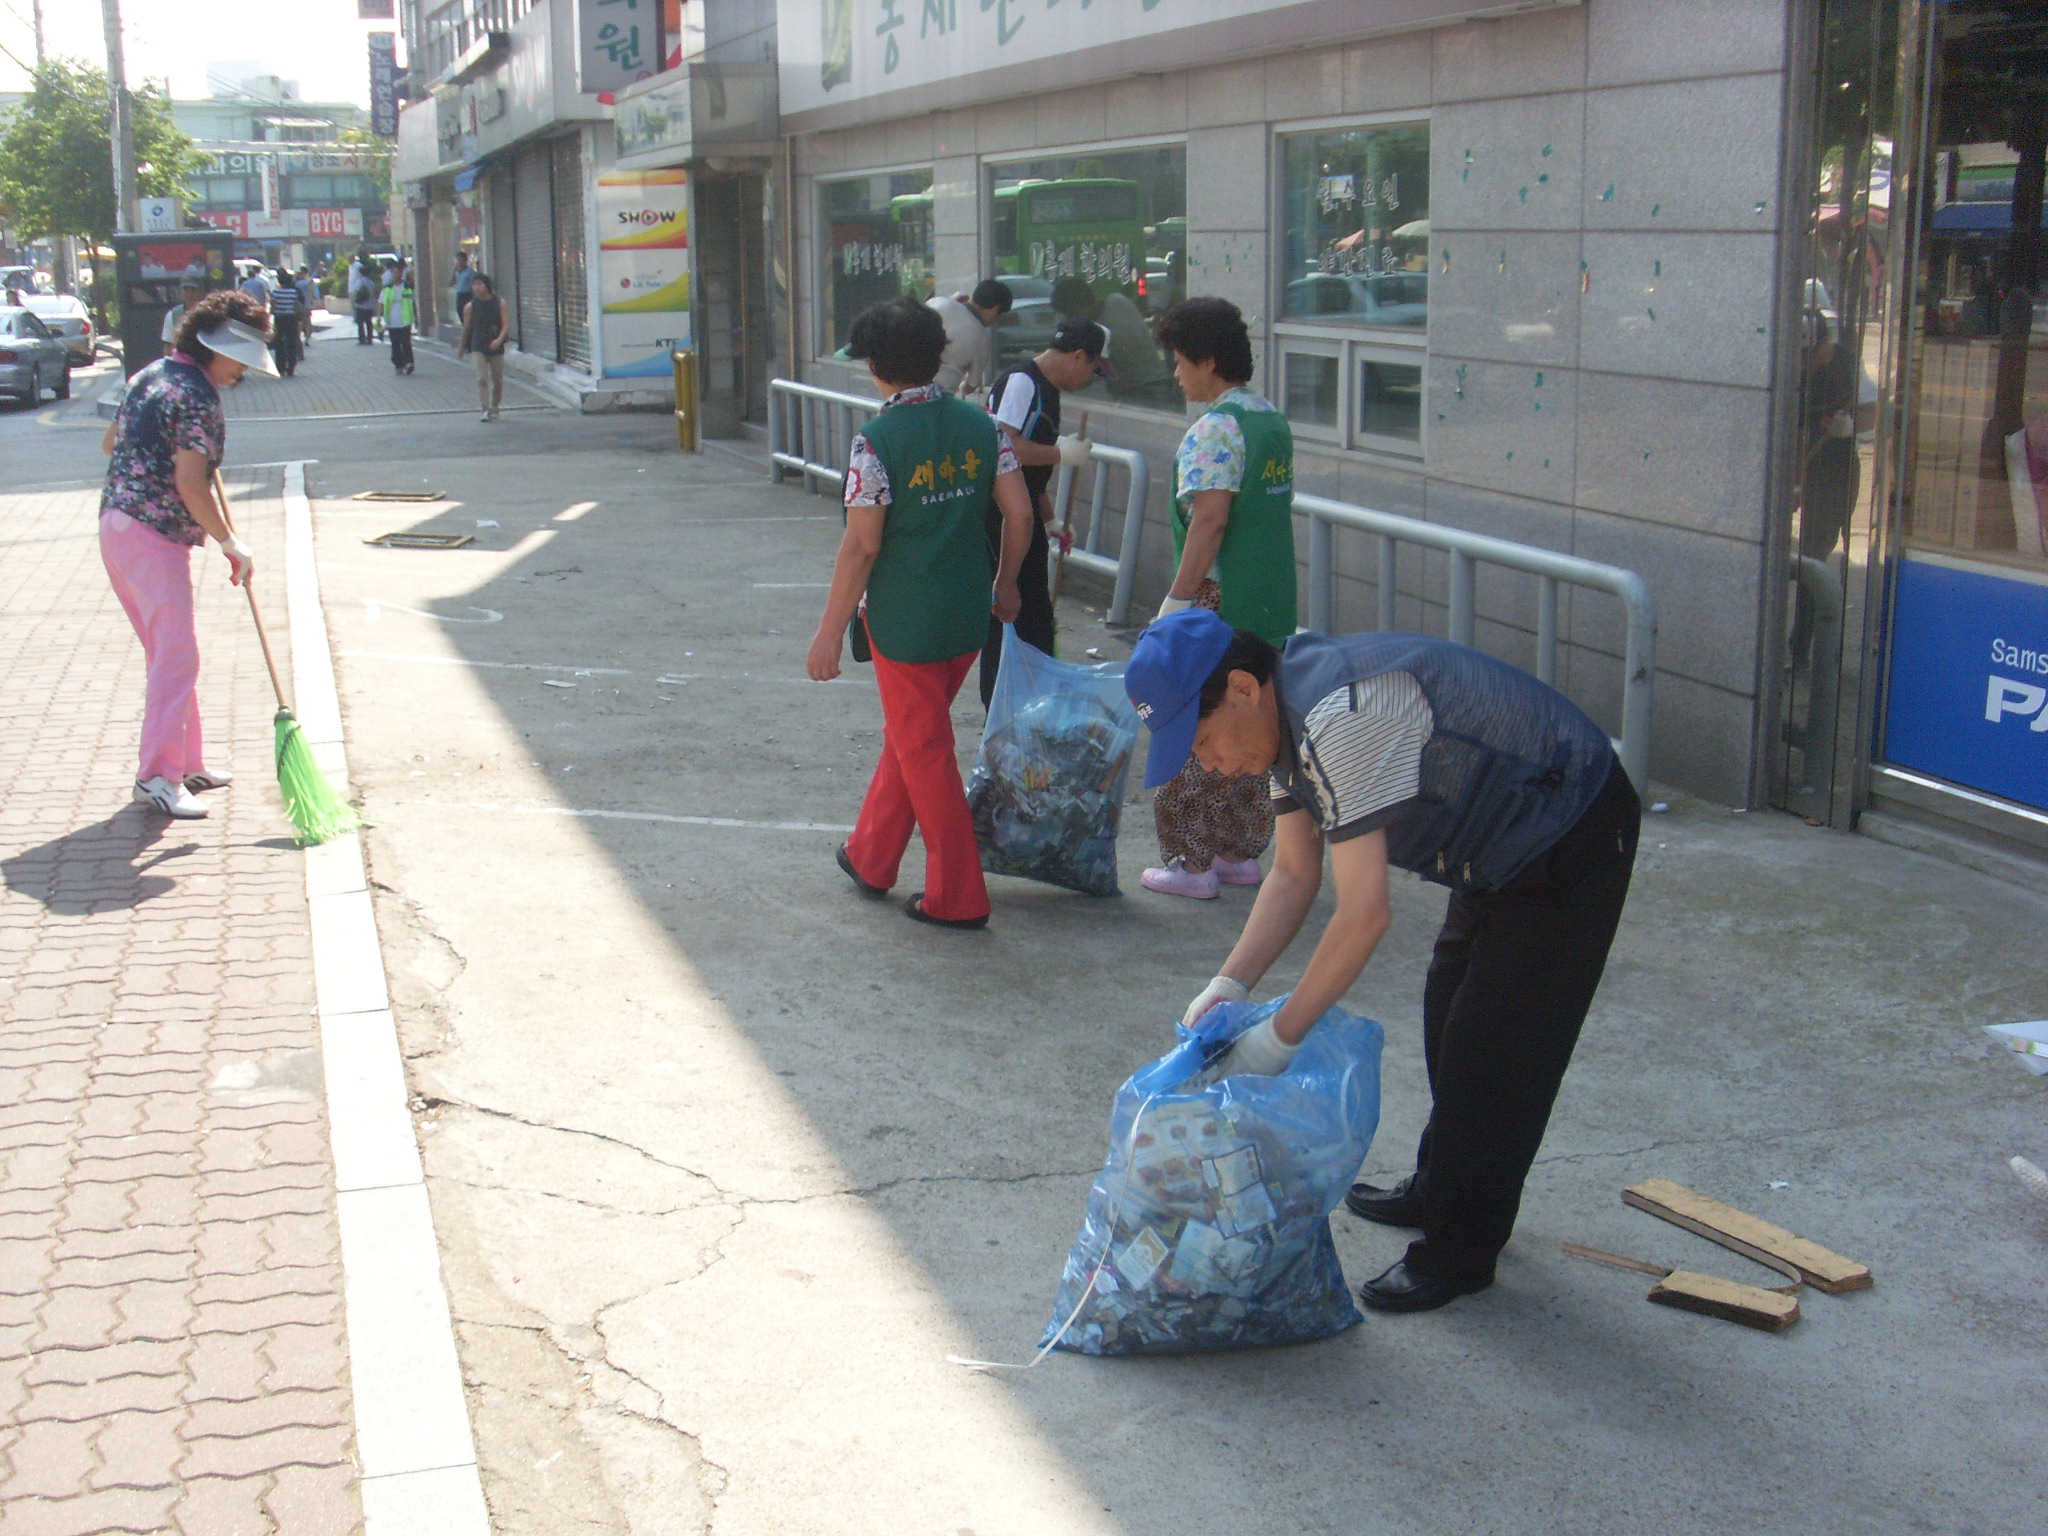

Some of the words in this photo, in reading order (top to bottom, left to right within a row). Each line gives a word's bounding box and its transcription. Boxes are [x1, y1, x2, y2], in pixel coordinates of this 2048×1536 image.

[310, 211, 342, 233] BYC
[618, 209, 676, 225] SHOW
[908, 448, 982, 491] 새마을
[1990, 637, 2048, 674] Sams
